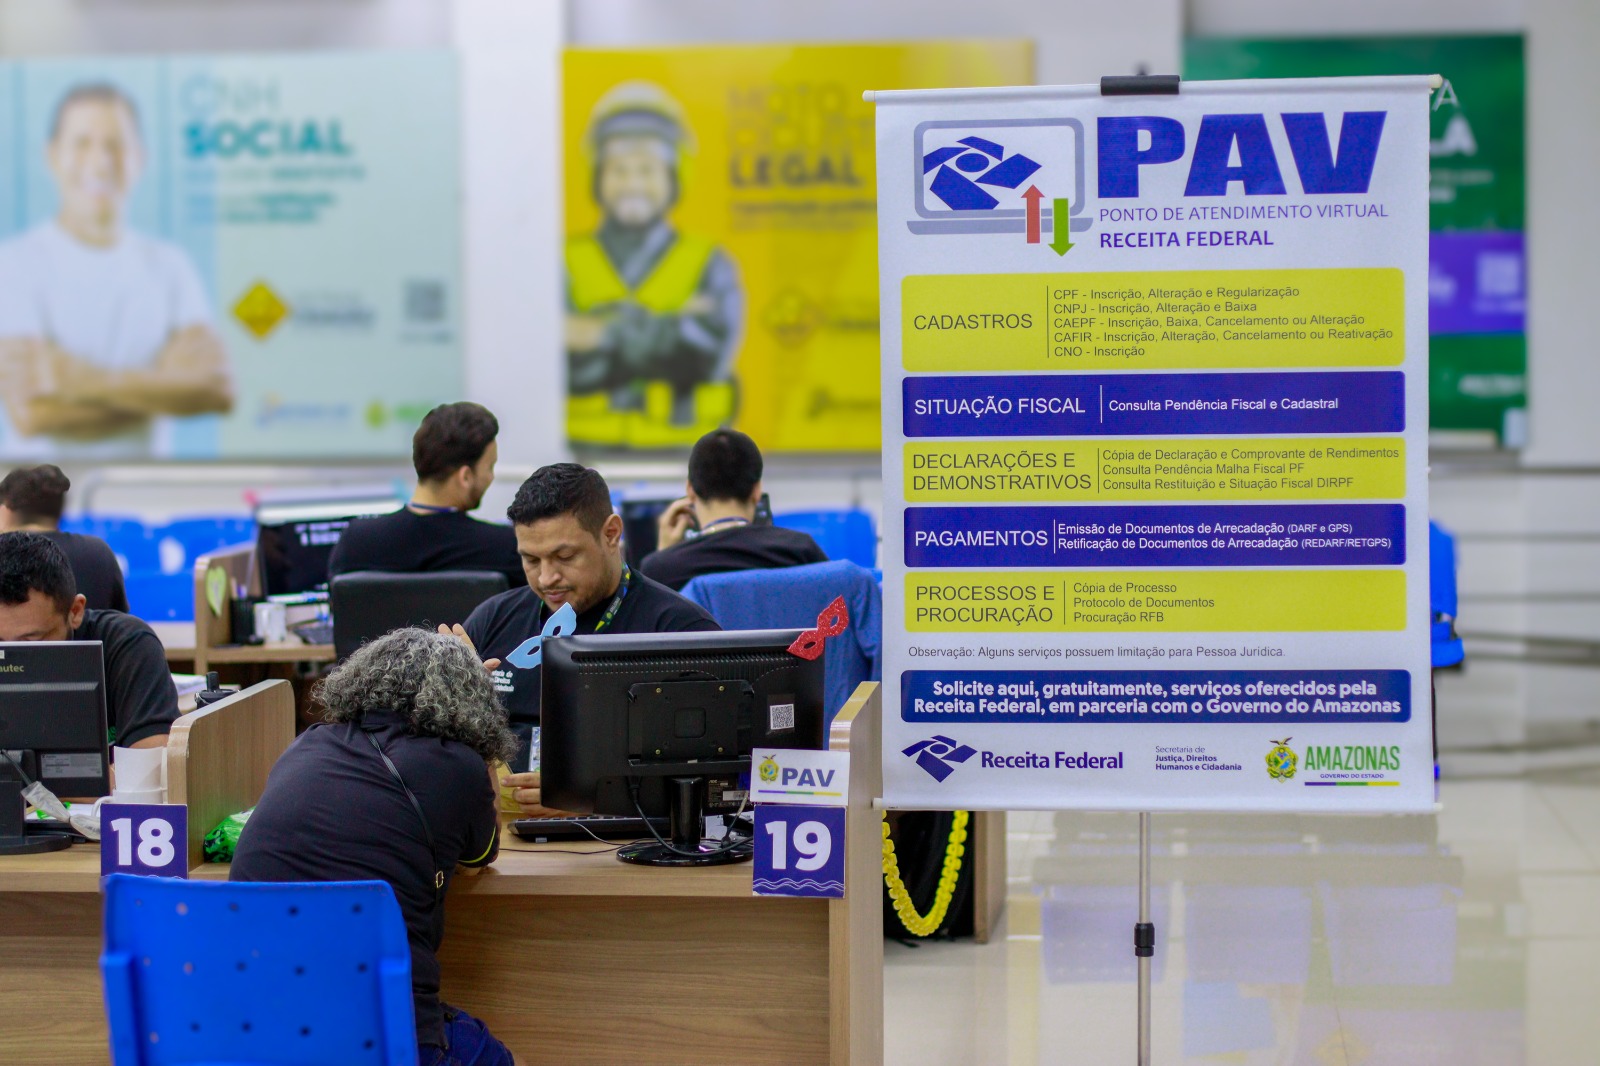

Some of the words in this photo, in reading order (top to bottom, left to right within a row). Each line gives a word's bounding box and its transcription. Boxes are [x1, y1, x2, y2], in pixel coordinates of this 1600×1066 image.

[183, 119, 353, 159] SOCIAL
[1097, 111, 1388, 198] PAV
[731, 152, 862, 188] LEGAL
[1100, 208, 1157, 221] PONTO
[1164, 208, 1187, 220] DE
[1191, 205, 1312, 220] ATENDIMENTO
[1317, 204, 1388, 217] VIRTUAL
[1101, 232, 1180, 248] RECEITA
[1187, 231, 1274, 246] FEDERAL
[1054, 290, 1078, 300] CPF
[1091, 289, 1144, 301] Inscrição,
[1148, 288, 1202, 300] Alteração
[1217, 287, 1299, 299] Regularização
[1054, 304, 1086, 314] CNPJ
[1099, 303, 1152, 315] Inscrição,
[1156, 303, 1210, 314] Alteração
[1225, 302, 1256, 311] Baixa
[914, 314, 1032, 330] CADASTROS
[1054, 318, 1096, 328] CAEPF
[1109, 318, 1161, 329] Inscrição,
[1167, 317, 1201, 328] Baixa,
[1206, 316, 1289, 326] Cancelamento
[1310, 315, 1364, 327] Alteração
[1054, 332, 1091, 342] CAFIR
[1104, 332, 1157, 344] Inscrição,
[1162, 331, 1218, 343] Alteração,
[1223, 330, 1306, 340] Cancelamento
[1329, 329, 1392, 341] Reativação
[1055, 347, 1082, 356] CNO
[1095, 346, 1145, 358] Inscrição
[915, 394, 1012, 418] SITUAÇÃO
[1019, 398, 1085, 413] FISCAL
[1109, 400, 1161, 411] Consulta
[1165, 399, 1227, 410] Pendência
[1232, 397, 1266, 409] Fiscal
[1270, 401, 1277, 409] e
[1281, 396, 1338, 409] Cadastral
[914, 451, 1057, 472] DECLARAÇÕES
[1061, 453, 1075, 467] E
[1103, 450, 1134, 462] Cópia
[1138, 450, 1151, 460] de
[1156, 450, 1217, 462] Declaração
[1231, 449, 1305, 461] Comprovante
[1309, 449, 1322, 458] de
[1327, 447, 1400, 458] Rendimentos
[1103, 465, 1150, 474] Consulta
[1155, 464, 1212, 474] Pendência
[1217, 464, 1249, 474] Malha
[1254, 464, 1285, 473] Fiscal
[1290, 463, 1304, 473] PF
[914, 474, 1091, 490] DEMONSTRATIVOS
[1103, 479, 1150, 489] Consulta
[1155, 479, 1215, 491] Restituição
[1230, 478, 1277, 490] Situação
[1282, 478, 1313, 488] Fiscal
[1317, 477, 1353, 488] DIRPF
[1059, 524, 1105, 534] Emissão
[1108, 524, 1122, 534] de
[1126, 523, 1194, 534] Documentos
[1198, 523, 1211, 533] de
[1214, 523, 1284, 535] Arrecadação
[1288, 524, 1317, 534] (DARF
[1328, 524, 1352, 534] GPS)
[916, 530, 1048, 546] PAGAMENTOS
[1059, 538, 1118, 551] Retificação
[1122, 538, 1135, 548] de
[1140, 538, 1208, 548] Documentos
[1211, 538, 1225, 548] de
[1228, 537, 1298, 550] Arrecadação
[1302, 538, 1391, 549] (REDARF/RETGPS)
[917, 586, 1036, 600] PROCESSOS
[1041, 586, 1054, 600] E
[1074, 583, 1105, 595] Cópia
[1109, 583, 1122, 592] de
[1126, 583, 1176, 594] Processo
[1073, 597, 1125, 610] Protocolo
[1127, 597, 1142, 610] de
[1146, 597, 1214, 607] Documentos
[917, 605, 1052, 626] PROCURAÇÃO
[1074, 612, 1136, 624] Procuração
[1140, 612, 1164, 622] RFB
[909, 647, 974, 659] Observação:
[978, 647, 1014, 659] Alguns
[1018, 646, 1061, 659] serviços
[1066, 649, 1113, 659] possuem
[1118, 647, 1165, 659] limitação
[1169, 649, 1192, 658] para
[1197, 647, 1236, 656] Pessoa
[1240, 647, 1286, 656] Jurídica.
[934, 681, 994, 695] Solicite
[998, 681, 1040, 702] aqui,
[1043, 681, 1167, 698] gratuitamente,
[1171, 681, 1241, 701] serviços
[1245, 681, 1336, 695] oferecidos
[1340, 680, 1376, 698] pela
[913, 698, 976, 715] Receita
[979, 699, 1047, 716] Federal,
[1049, 702, 1074, 712] em
[1078, 698, 1149, 717] parceria
[1152, 702, 1190, 713] com
[1193, 702, 1203, 713] o
[1206, 698, 1282, 715] Governo
[1286, 698, 1309, 713] do
[1313, 699, 1402, 715] Amazonas
[982, 751, 1049, 768] Receita
[1055, 752, 1123, 768] Federal
[1156, 755, 1184, 763] Justiça,
[1305, 746, 1400, 770] AMAZONAS
[782, 768, 835, 787] PAV
[111, 818, 175, 867] 18
[765, 821, 832, 871] 19
